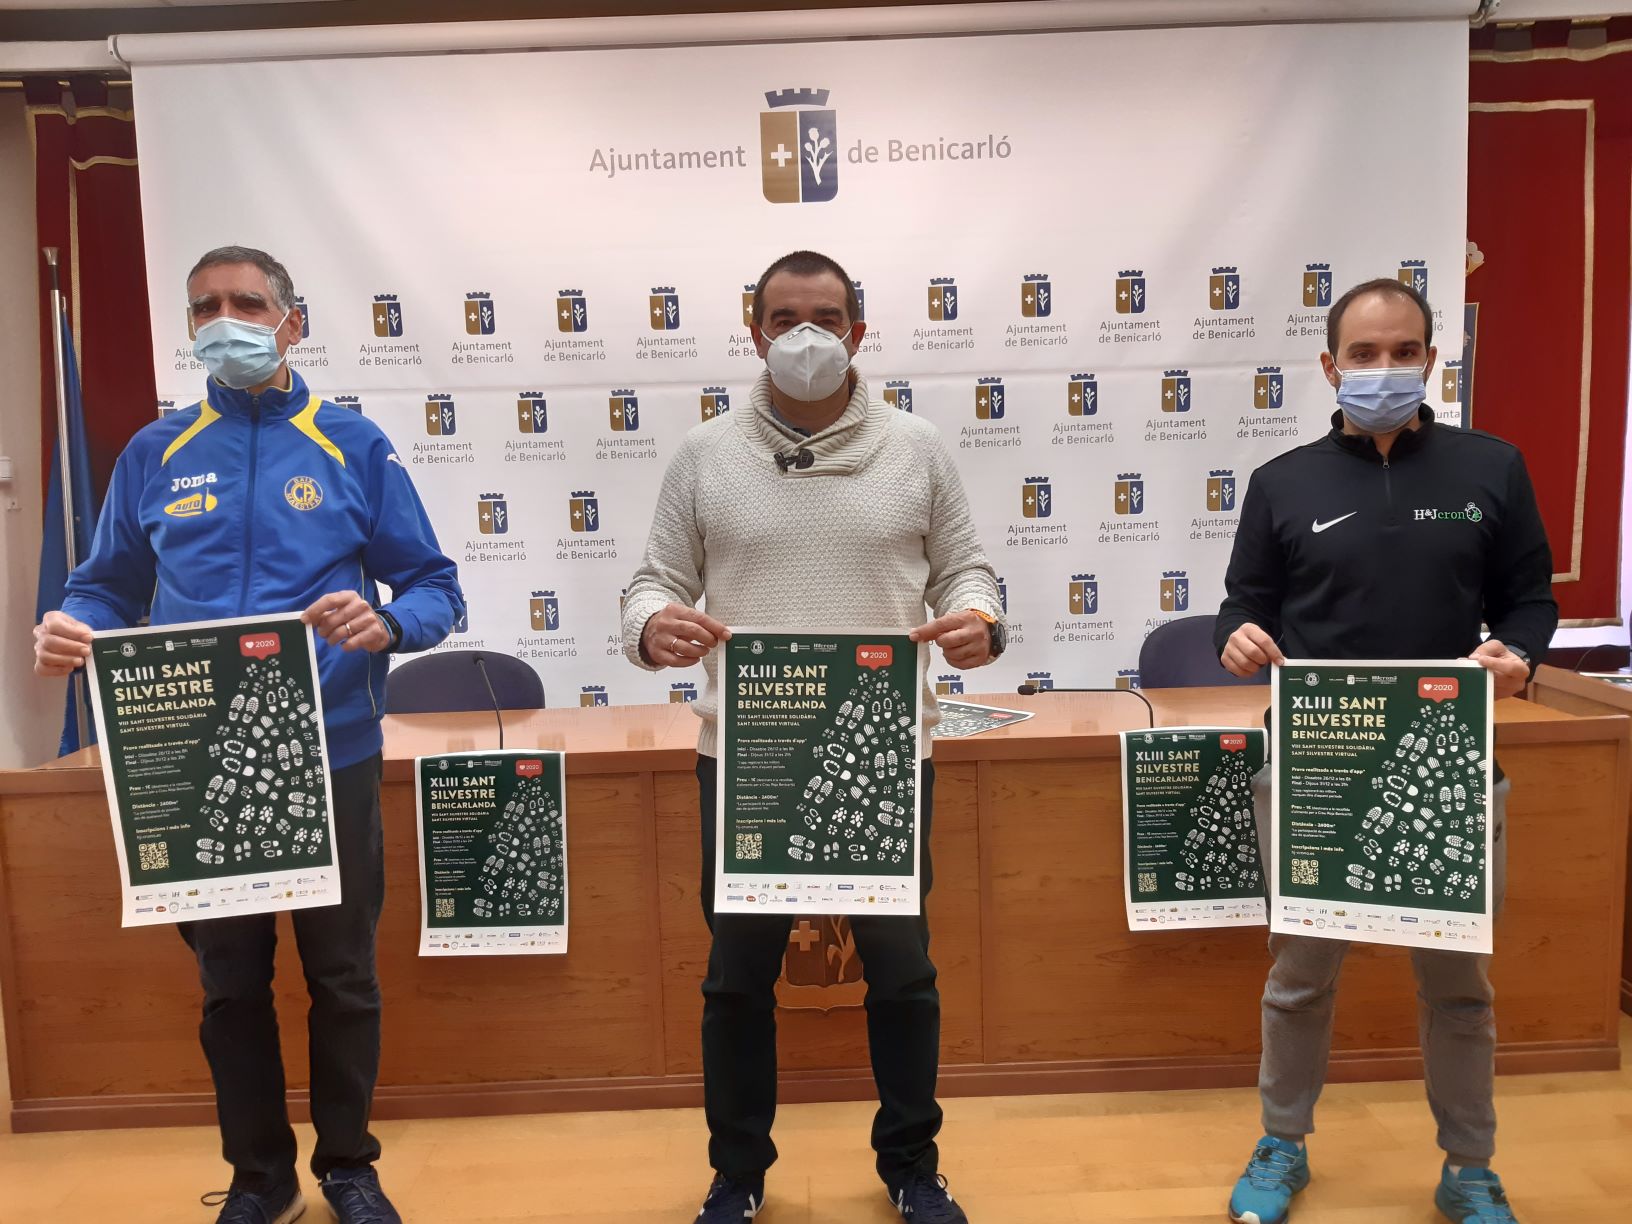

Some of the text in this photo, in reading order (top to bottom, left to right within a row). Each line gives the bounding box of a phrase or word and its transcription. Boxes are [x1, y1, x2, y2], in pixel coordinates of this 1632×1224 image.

[590, 134, 1012, 178] Ajuntament de Benicarló
[1099, 320, 1159, 331] Ajuntament
[1193, 316, 1254, 328] Ajuntament
[912, 327, 972, 338] Ajuntament
[1005, 324, 1065, 335] Ajuntament
[1193, 329, 1256, 340] de Benicarló
[1286, 326, 1328, 336] de Benic
[636, 336, 695, 347] Ajuntament
[1005, 336, 1067, 348] de Benicarló
[1099, 332, 1161, 344] de Benicarló
[287, 345, 326, 355] tament
[359, 344, 420, 354] Ajuntament
[452, 342, 511, 352] Ajuntament
[544, 339, 604, 350] Ajuntament
[912, 339, 974, 350] de Benicarló
[544, 351, 606, 362] de Benicarló
[636, 348, 697, 360] de Benicarló
[728, 348, 740, 357] de
[288, 358, 329, 367] enicarló
[359, 355, 422, 366] de Benicarló
[452, 353, 513, 364] de Benicarló
[174, 361, 187, 370] de
[1145, 418, 1205, 429] Ajuntament
[1237, 416, 1296, 427] Ajuntament
[960, 426, 1019, 437] Ajuntament
[1052, 422, 1112, 433] Ajuntament
[1237, 428, 1298, 438] de Benicarló
[1052, 434, 1114, 444] de Benicarló
[1145, 430, 1207, 442] de Benicarló
[411, 442, 472, 453] Ajuntament
[505, 440, 564, 450] Ajuntament
[596, 438, 655, 448] Ajuntament
[960, 438, 1021, 448] de Benicarló
[411, 454, 474, 464] de Benicarló
[505, 451, 566, 462] de Benicarló
[596, 449, 657, 460] de Benicarló
[174, 500, 200, 511] AUTO
[1098, 521, 1157, 531] Ajuntament
[1191, 518, 1239, 529] Ajuntame
[1007, 524, 1066, 535] Ajuntament
[1190, 530, 1237, 539] de Benica
[1007, 536, 1068, 546] de Benicarló
[1098, 532, 1159, 542] de Benicarló
[465, 540, 524, 551] Ajuntament
[556, 538, 615, 548] Ajuntament
[465, 552, 526, 562] de Benicarló
[556, 549, 617, 560] de Benicarló
[1054, 621, 1112, 631] Ajuntament
[516, 637, 575, 647] Ajuntament
[1054, 632, 1114, 642] de Benicarló
[516, 648, 577, 658] de Benicarló
[606, 647, 618, 655] de
[110, 660, 211, 683] XLIII SANT
[738, 665, 828, 678] XLIII SANT
[114, 679, 214, 701] SILVESTRE
[738, 682, 827, 696] SILVESTRE
[116, 697, 216, 716] BENICARLANDA
[737, 700, 826, 709] BENICARLANDA
[1292, 696, 1387, 710] XLIII SANT
[1292, 713, 1386, 728] SILVESTRE
[1292, 730, 1386, 740] BENICARLANDA
[1136, 750, 1200, 761] XLIII SANT
[1136, 763, 1200, 774] SILVESTRE
[430, 776, 496, 787] XLIII SANT
[1136, 775, 1200, 784] BENICARLANDA
[431, 789, 496, 800] SILVESTRE
[431, 801, 496, 810] BENICARLANDA
